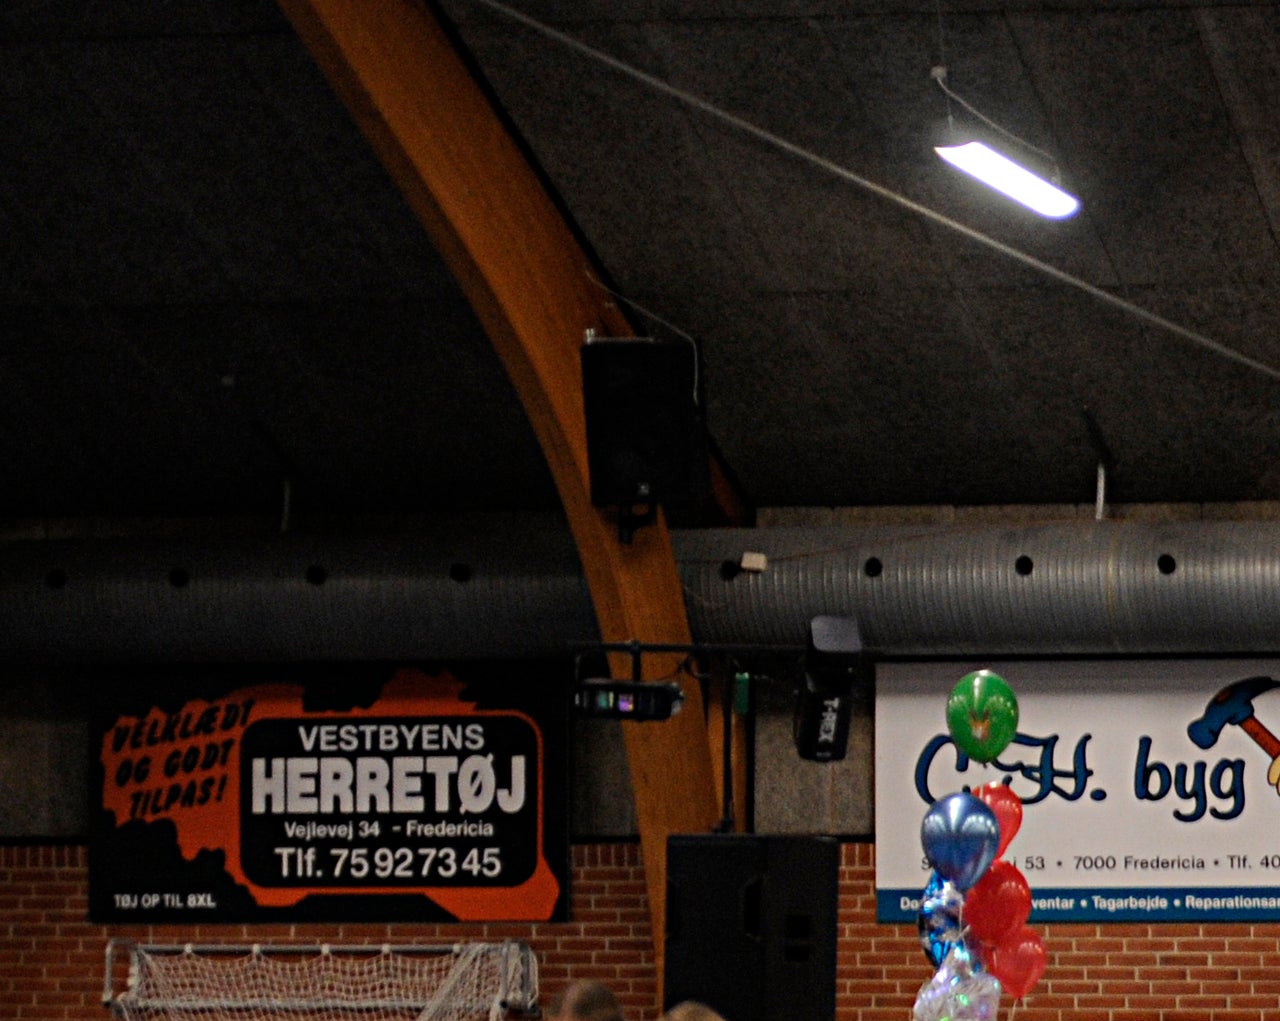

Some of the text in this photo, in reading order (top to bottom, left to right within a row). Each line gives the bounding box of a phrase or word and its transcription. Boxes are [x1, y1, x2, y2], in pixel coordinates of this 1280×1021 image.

[299, 724, 485, 751] VESTBYENS
[115, 739, 234, 787] OG GODT
[252, 753, 526, 815] HERRETØJ
[1134, 736, 1245, 822] byg
[130, 775, 227, 818] TILPAS!
[285, 820, 353, 840] Vejlevej
[359, 821, 381, 837] 34
[406, 820, 494, 838] Fredericia
[275, 848, 322, 878] Tlf.
[1025, 856, 1045, 870] 53
[1074, 856, 1116, 870] 7000
[1124, 855, 1205, 869] Fredericia
[1227, 855, 1252, 868] Tlf.
[141, 893, 160, 908] OP
[163, 893, 184, 908] TIL
[1094, 896, 1168, 912] Tagarbejde
